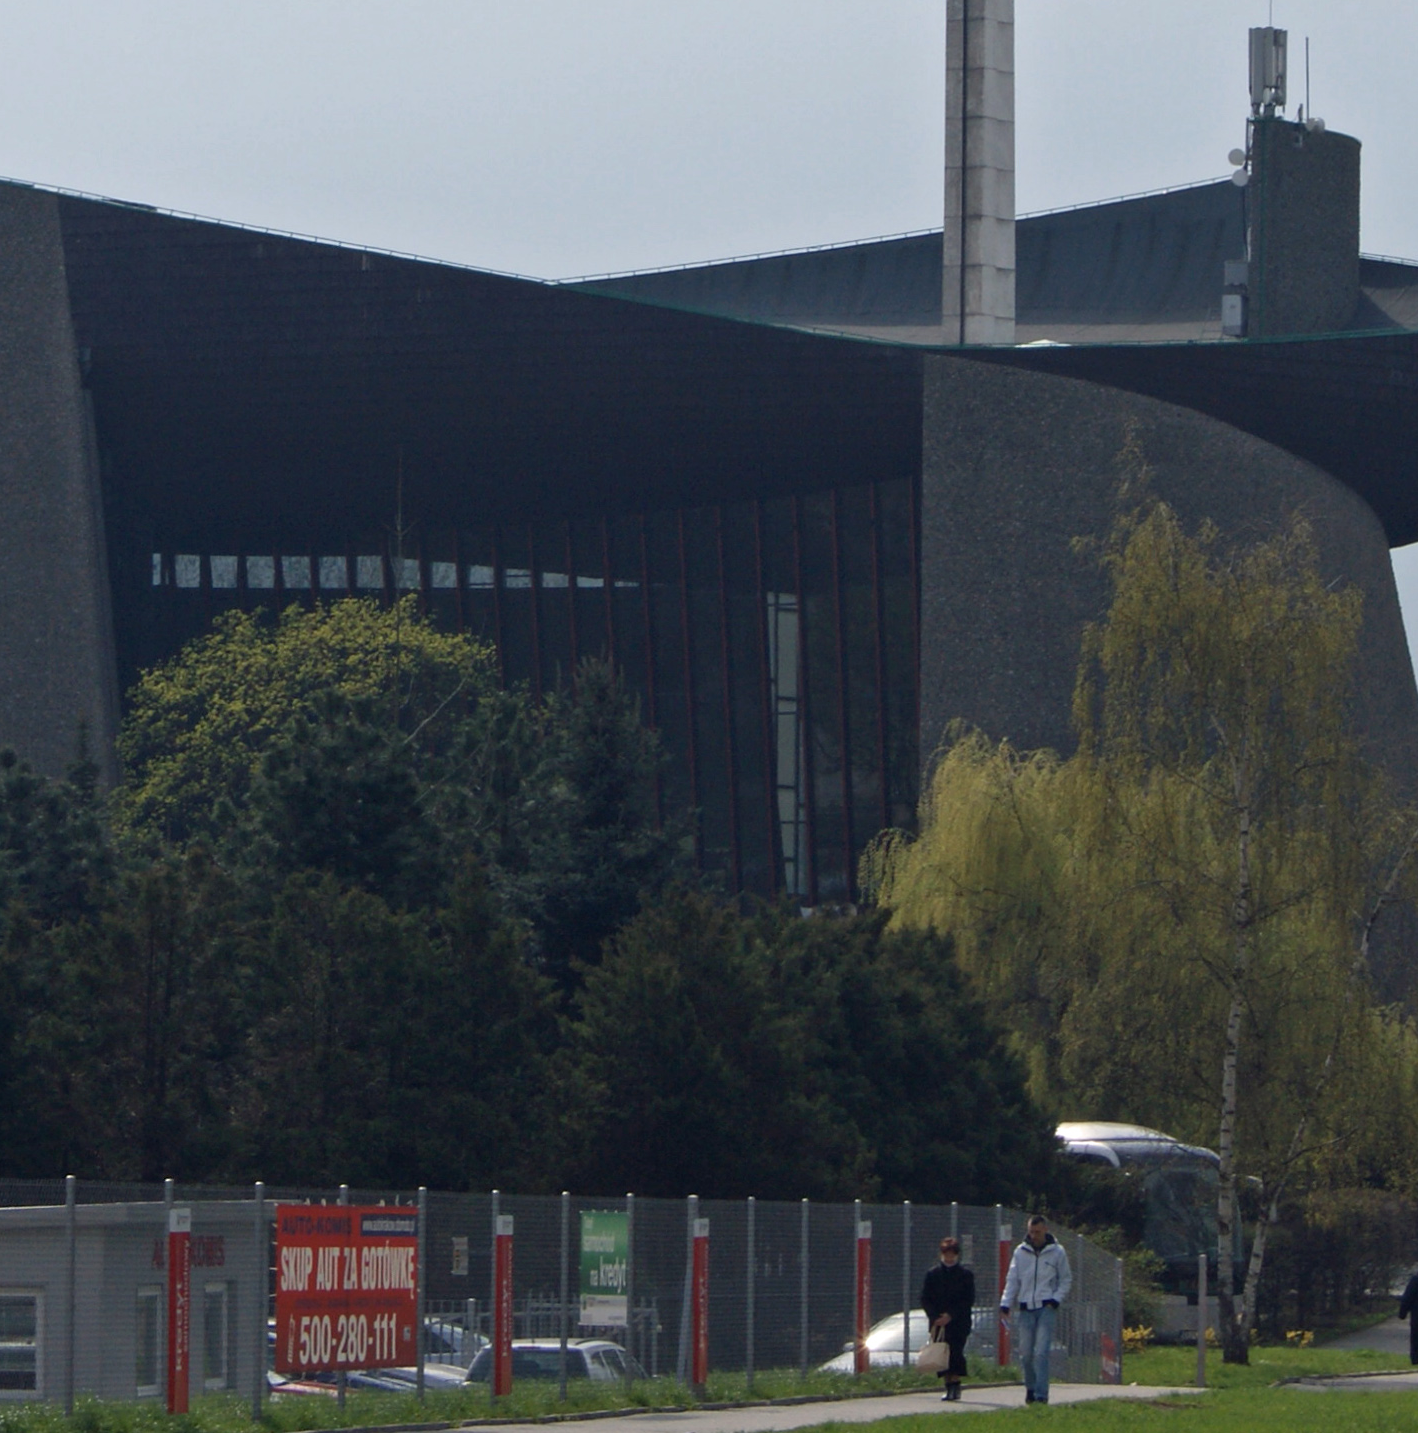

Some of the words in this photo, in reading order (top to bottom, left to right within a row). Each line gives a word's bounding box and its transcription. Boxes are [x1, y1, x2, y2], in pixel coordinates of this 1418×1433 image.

[281, 1246, 313, 1291] SKUP
[316, 1246, 340, 1291] AUT
[343, 1247, 358, 1290] ZA
[361, 1239, 415, 1300] GOTÓWKĘ
[599, 1255, 627, 1294] kredyt
[299, 1312, 397, 1365] 500-280-111
